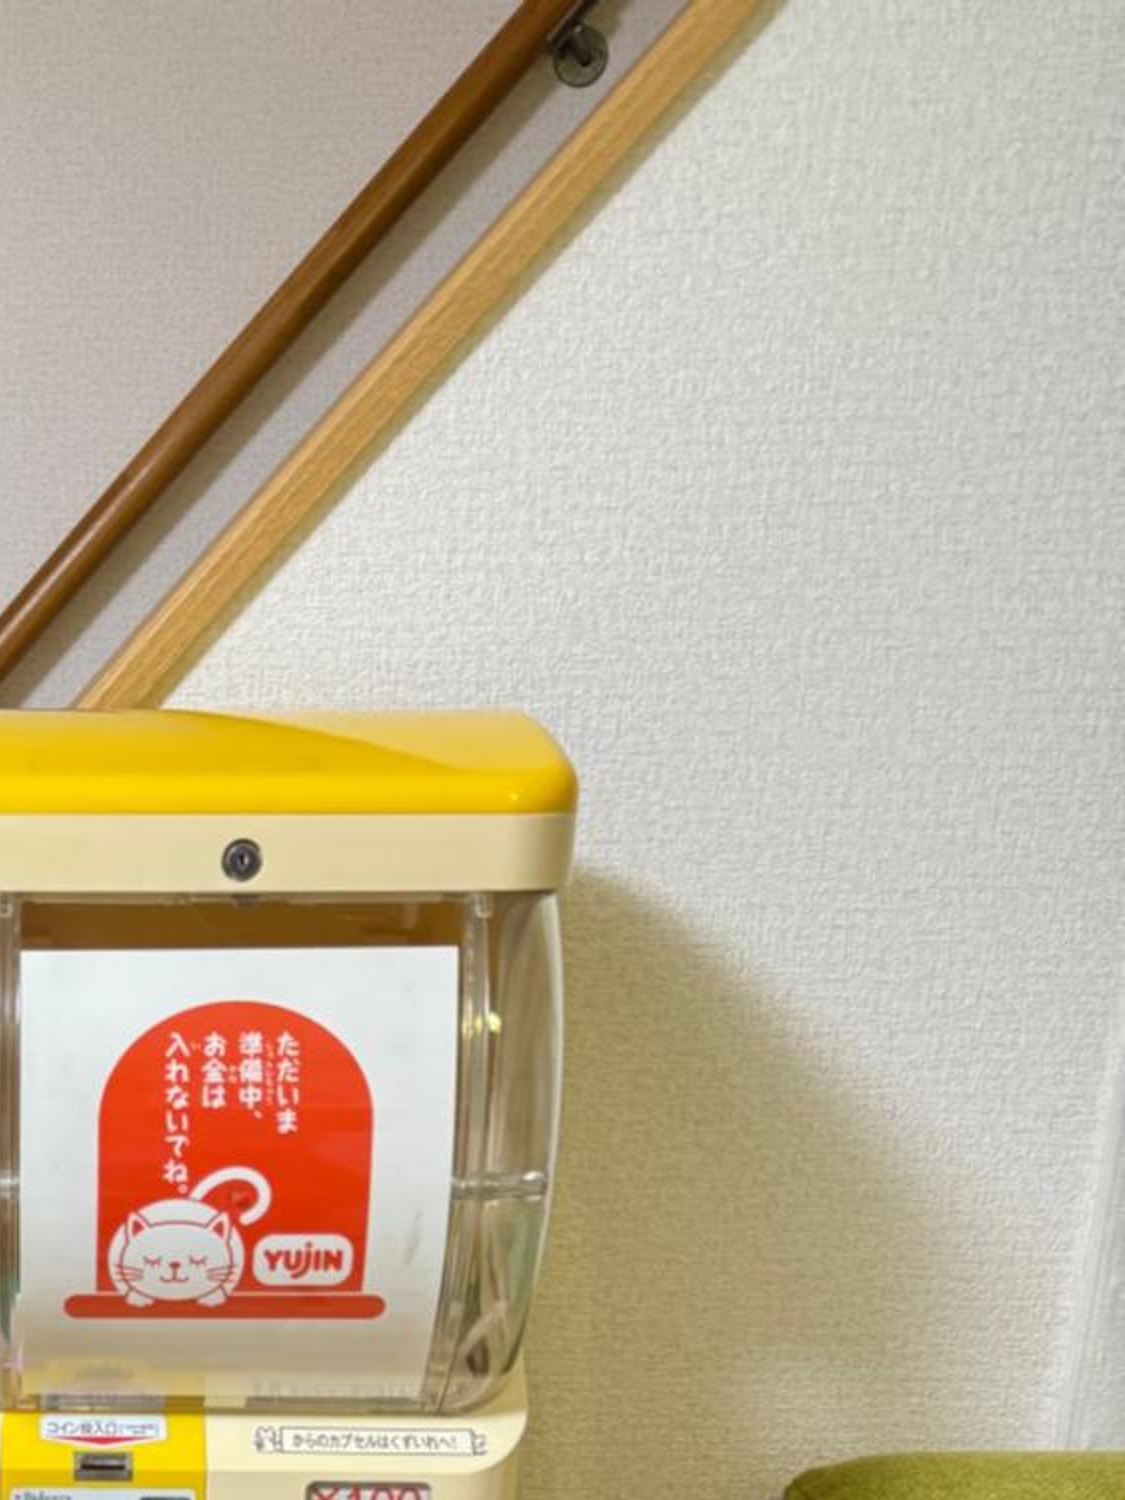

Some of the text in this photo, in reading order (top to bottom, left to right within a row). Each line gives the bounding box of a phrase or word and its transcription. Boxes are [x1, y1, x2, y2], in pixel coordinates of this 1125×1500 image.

[163, 1031, 191, 1195] 入れないでね。
[201, 1030, 227, 1110] お金は
[239, 1030, 264, 1119] 準備中、
[276, 1030, 300, 1135] ただいま
